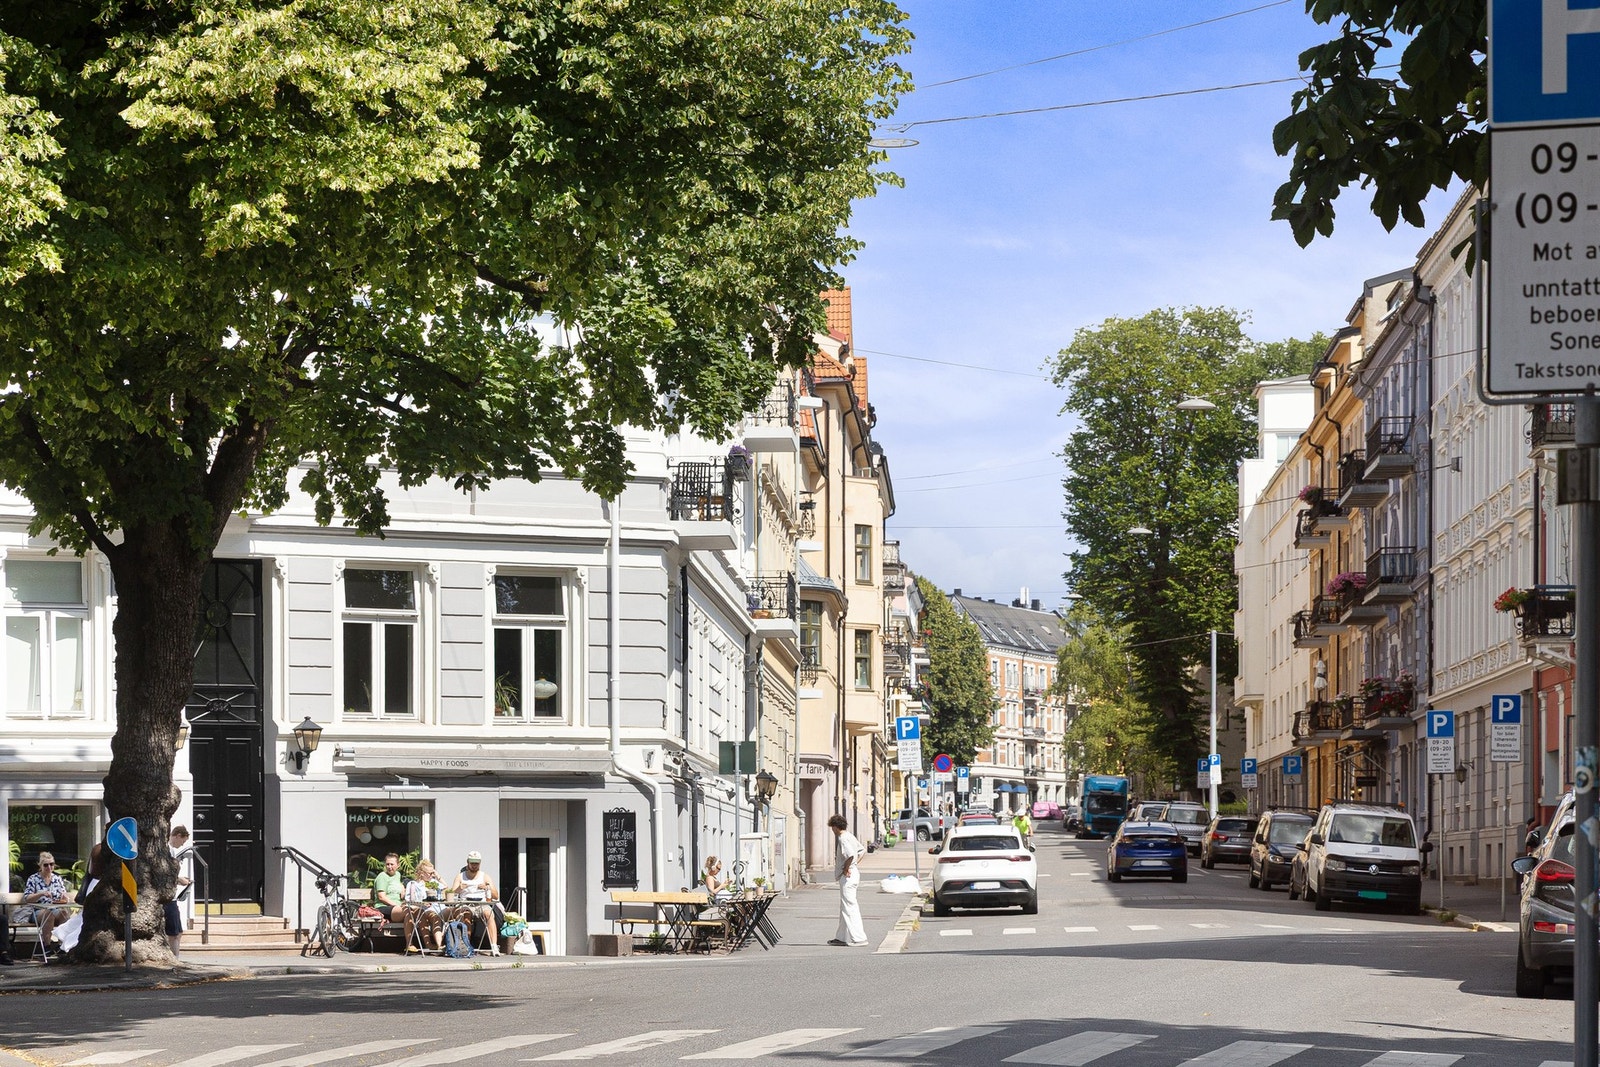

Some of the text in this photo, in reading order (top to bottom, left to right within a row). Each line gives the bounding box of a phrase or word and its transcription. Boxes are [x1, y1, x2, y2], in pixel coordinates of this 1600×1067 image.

[1533, 242, 1600, 261] Mot a
[1550, 331, 1600, 350] Sone
[1514, 362, 1600, 379] Takstson
[1499, 699, 1514, 720] P
[901, 719, 914, 738] P
[1434, 714, 1448, 734] P
[445, 760, 470, 768] FOODS
[1201, 760, 1208, 770] P
[1244, 760, 1253, 772] P
[1287, 758, 1298, 773] P
[960, 768, 967, 777] P
[11, 813, 47, 823] HAPPY
[348, 814, 420, 824] HAPPY FOODS
